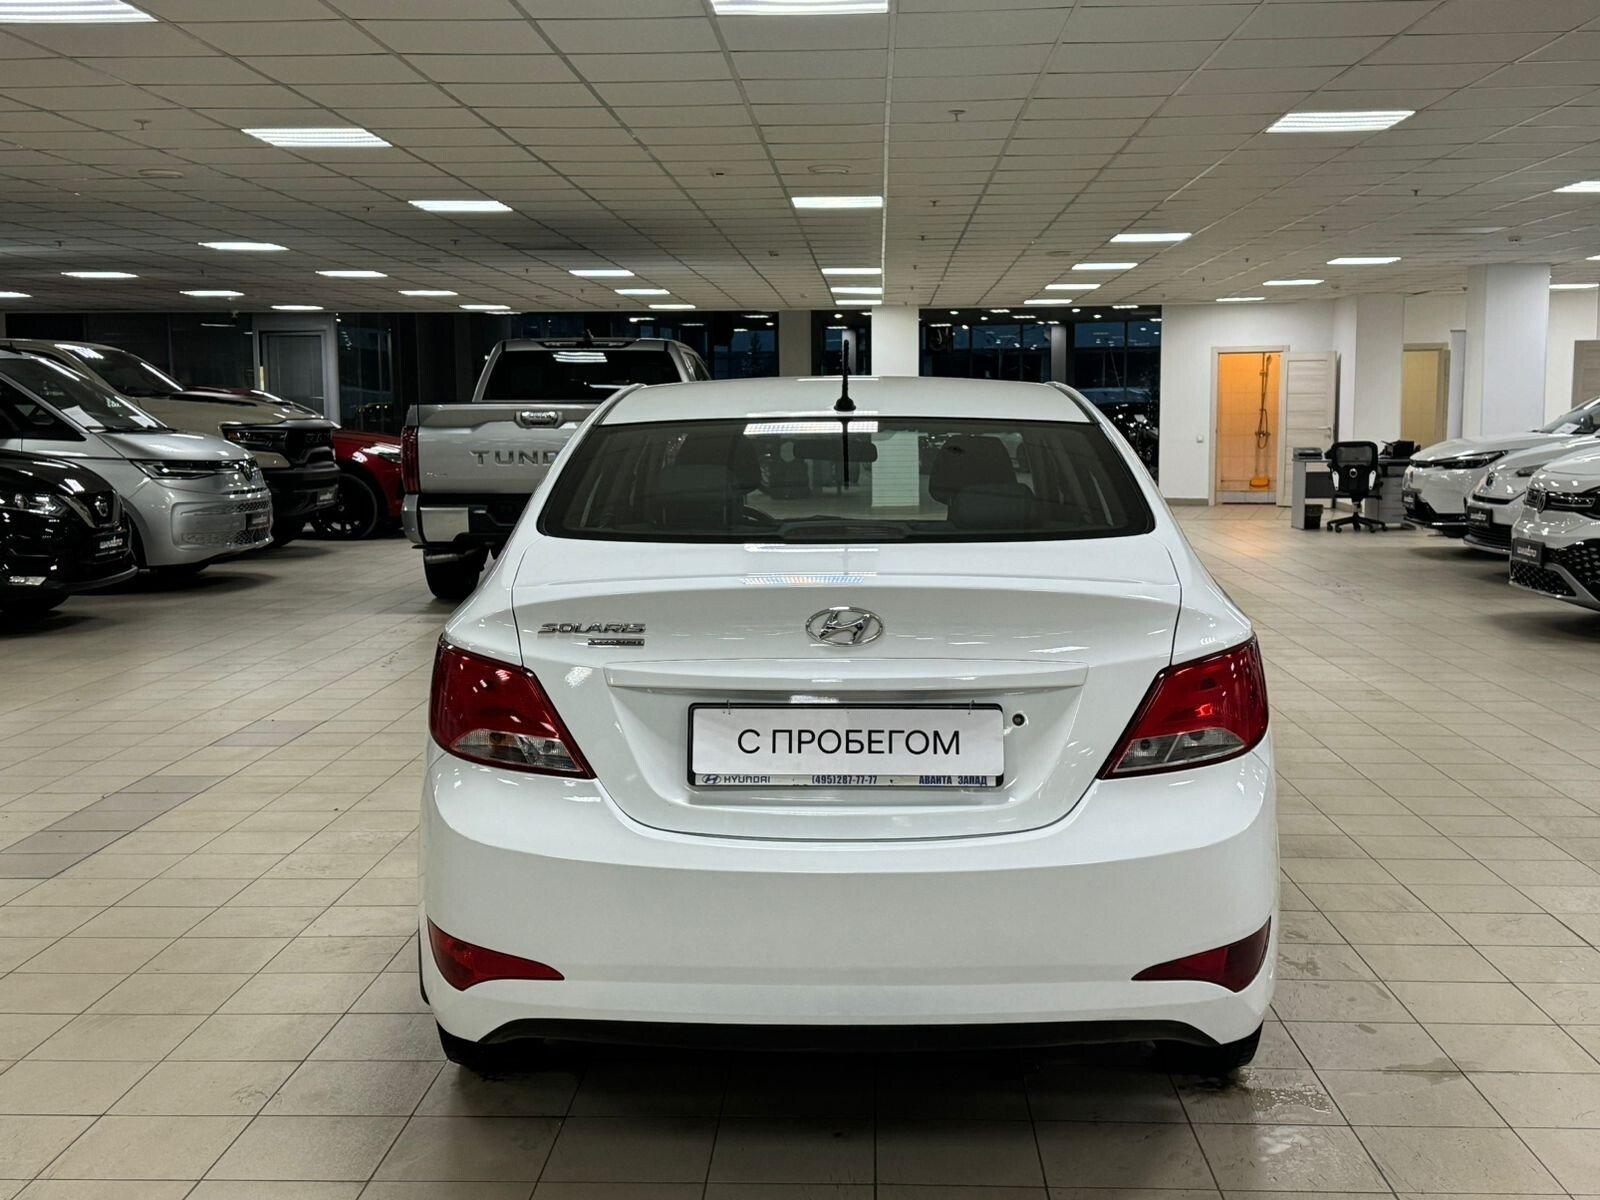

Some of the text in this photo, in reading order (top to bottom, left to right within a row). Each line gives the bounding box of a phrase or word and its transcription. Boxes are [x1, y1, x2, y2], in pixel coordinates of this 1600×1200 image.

[538, 622, 646, 634] SOLARIS
[737, 729, 960, 755] С ПРОБЕГОМ
[723, 775, 771, 784] HYUNDAI
[811, 774, 878, 785] (495)287-77-77
[918, 775, 988, 787] АВАНТА ЗАПАД
